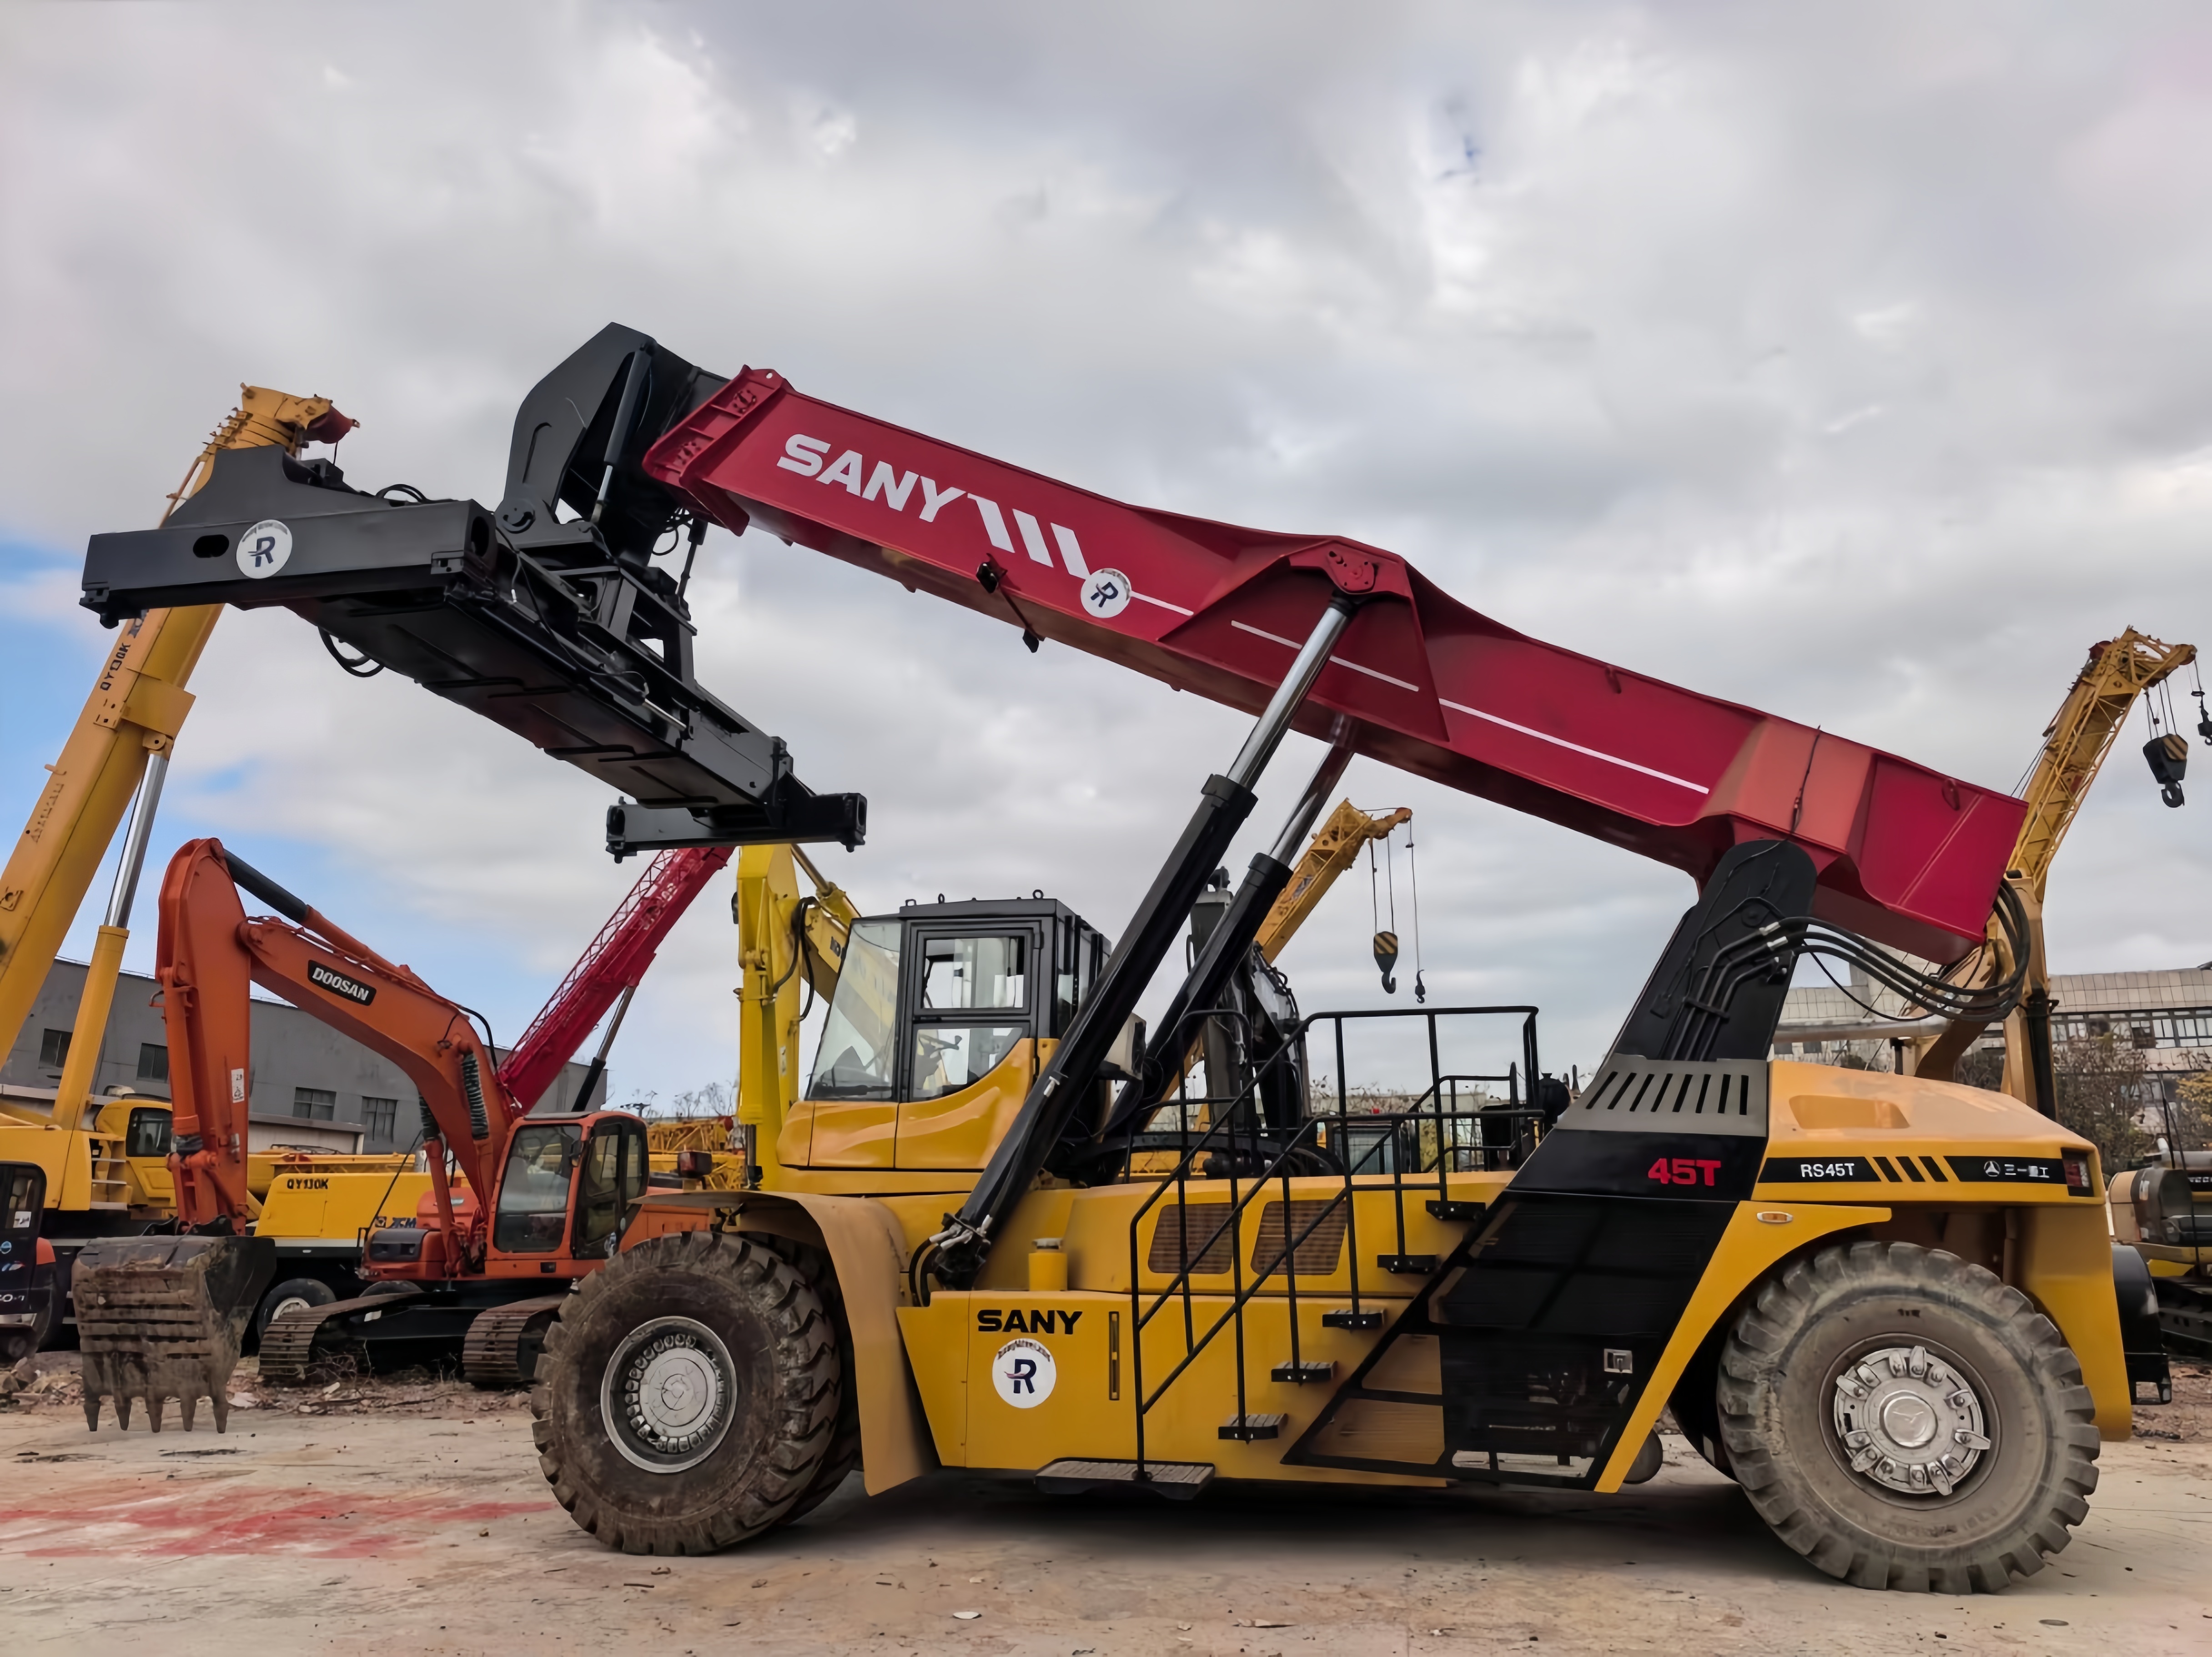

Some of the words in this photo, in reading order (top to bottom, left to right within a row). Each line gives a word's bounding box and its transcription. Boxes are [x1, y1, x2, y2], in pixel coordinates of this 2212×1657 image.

[777, 434, 966, 522] SANY
[312, 967, 369, 1001] DOOSAN
[1648, 1158, 1722, 1186] 45T
[1800, 1163, 1855, 1178] RS45T
[977, 1310, 1083, 1335] SANY
